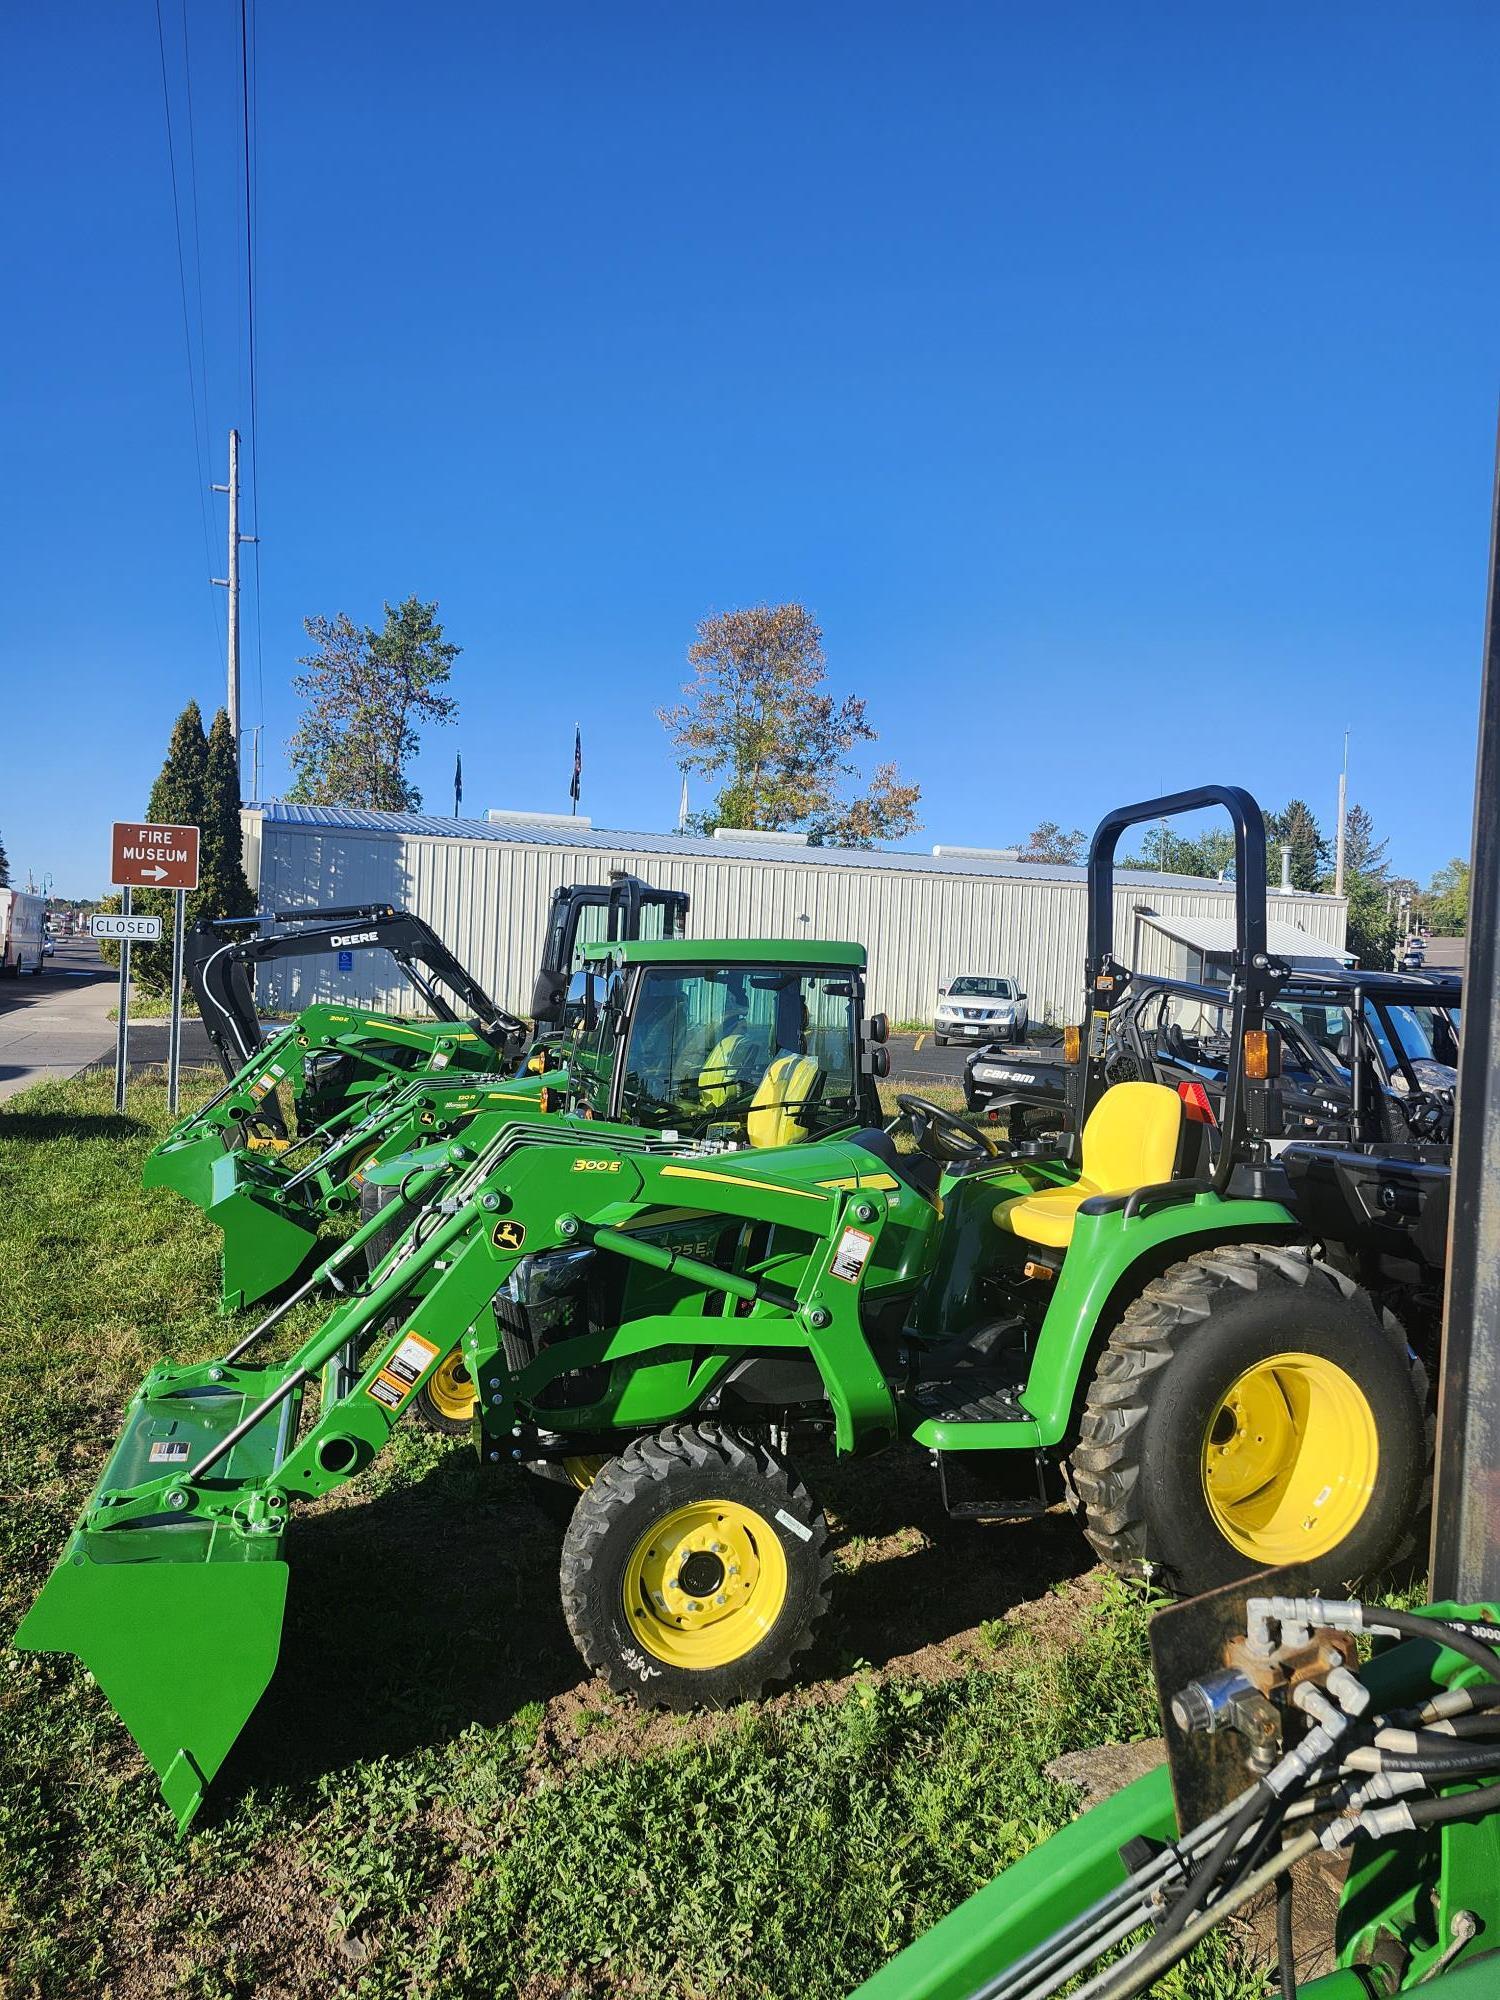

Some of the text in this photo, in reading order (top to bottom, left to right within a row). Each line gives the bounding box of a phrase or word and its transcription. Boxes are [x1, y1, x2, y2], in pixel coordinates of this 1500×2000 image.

[139, 830, 173, 844] FIRE
[123, 847, 187, 862] MUSEUM
[96, 920, 156, 934] CLOSED
[330, 931, 379, 947] DEERE
